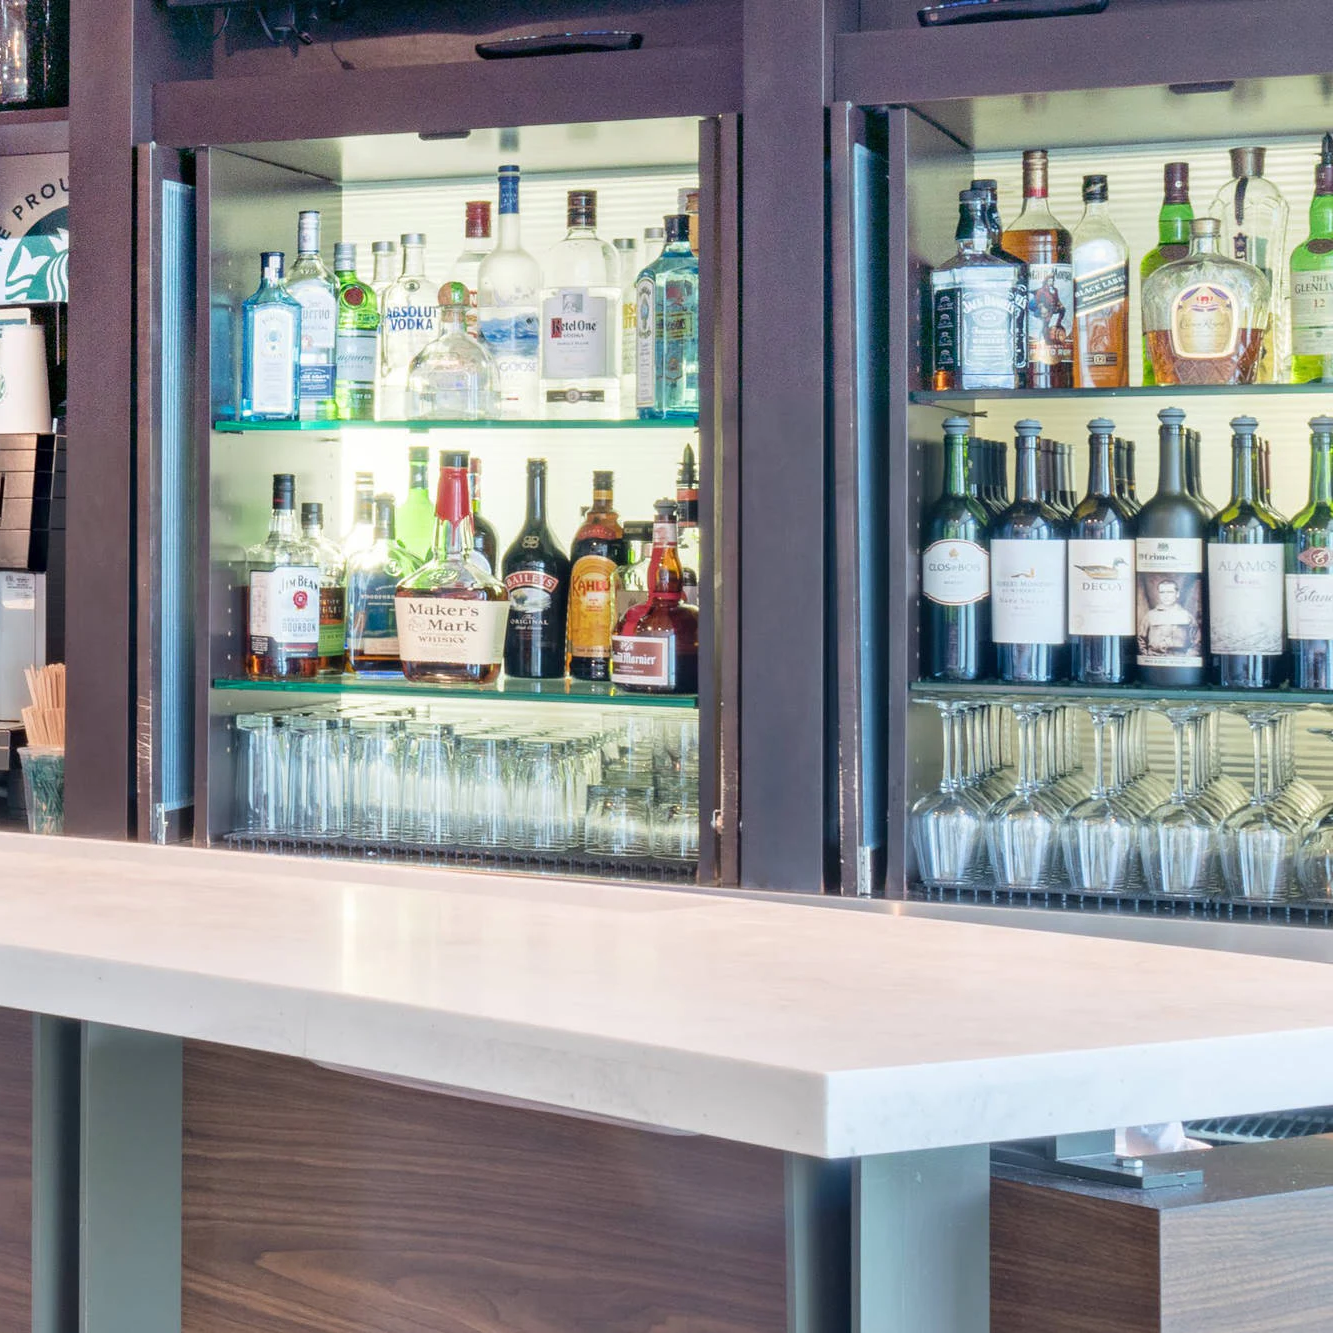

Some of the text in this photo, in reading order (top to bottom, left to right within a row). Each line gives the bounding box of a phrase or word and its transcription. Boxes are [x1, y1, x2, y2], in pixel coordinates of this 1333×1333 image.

[1075, 281, 1103, 298] BLACK
[1314, 299, 1326, 309] 12
[386, 305, 438, 319] ABSOLUT
[390, 318, 433, 330] VODKA
[578, 320, 597, 332] One
[928, 563, 951, 573] CLOS
[1218, 560, 1279, 572] ALAMOS
[279, 578, 296, 594] JIM
[506, 572, 555, 588] BAILEYS
[1082, 582, 1125, 592] DECOY
[408, 603, 479, 617] Maker's
[427, 619, 478, 632] Mark
[418, 635, 467, 644] WHISKY
